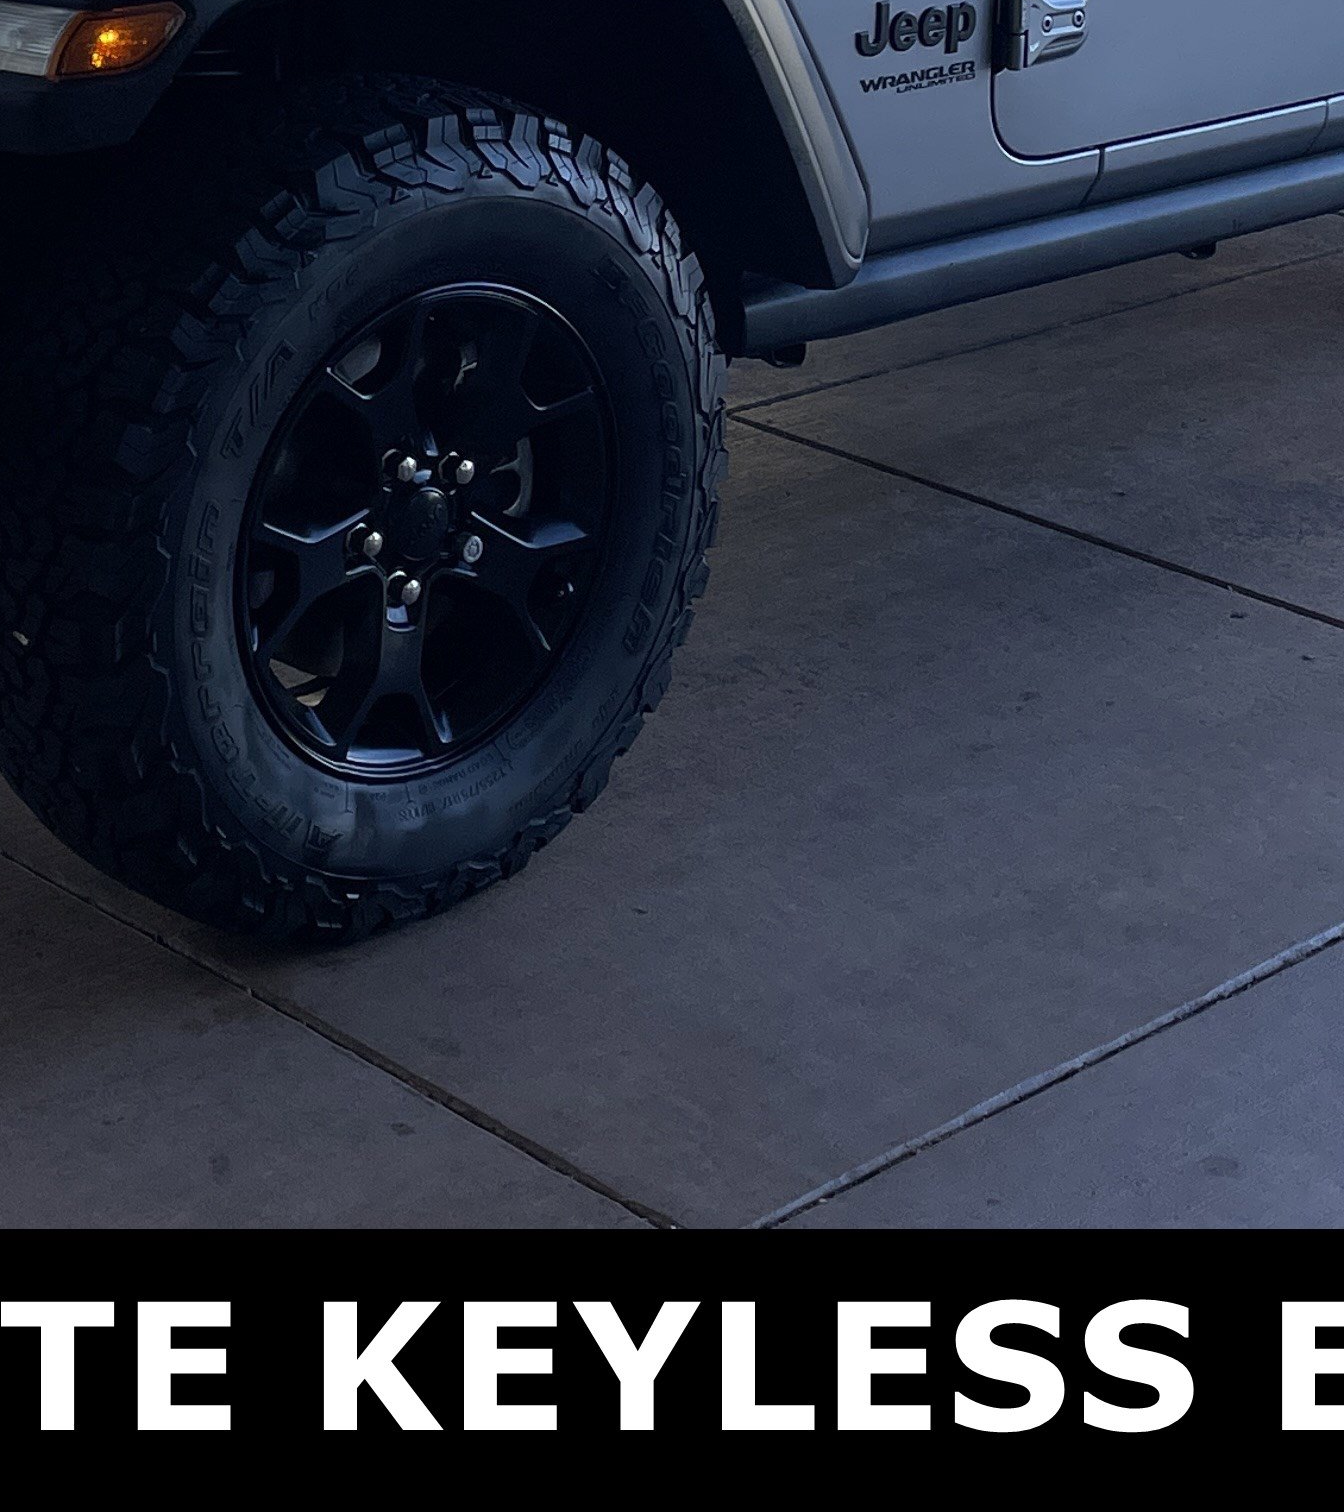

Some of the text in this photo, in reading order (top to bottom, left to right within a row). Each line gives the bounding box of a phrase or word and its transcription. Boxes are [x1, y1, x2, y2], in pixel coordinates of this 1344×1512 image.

[854, 0, 976, 57] Jeep
[859, 60, 976, 93] WRANGLER
[895, 72, 976, 94] UNLIMITED
